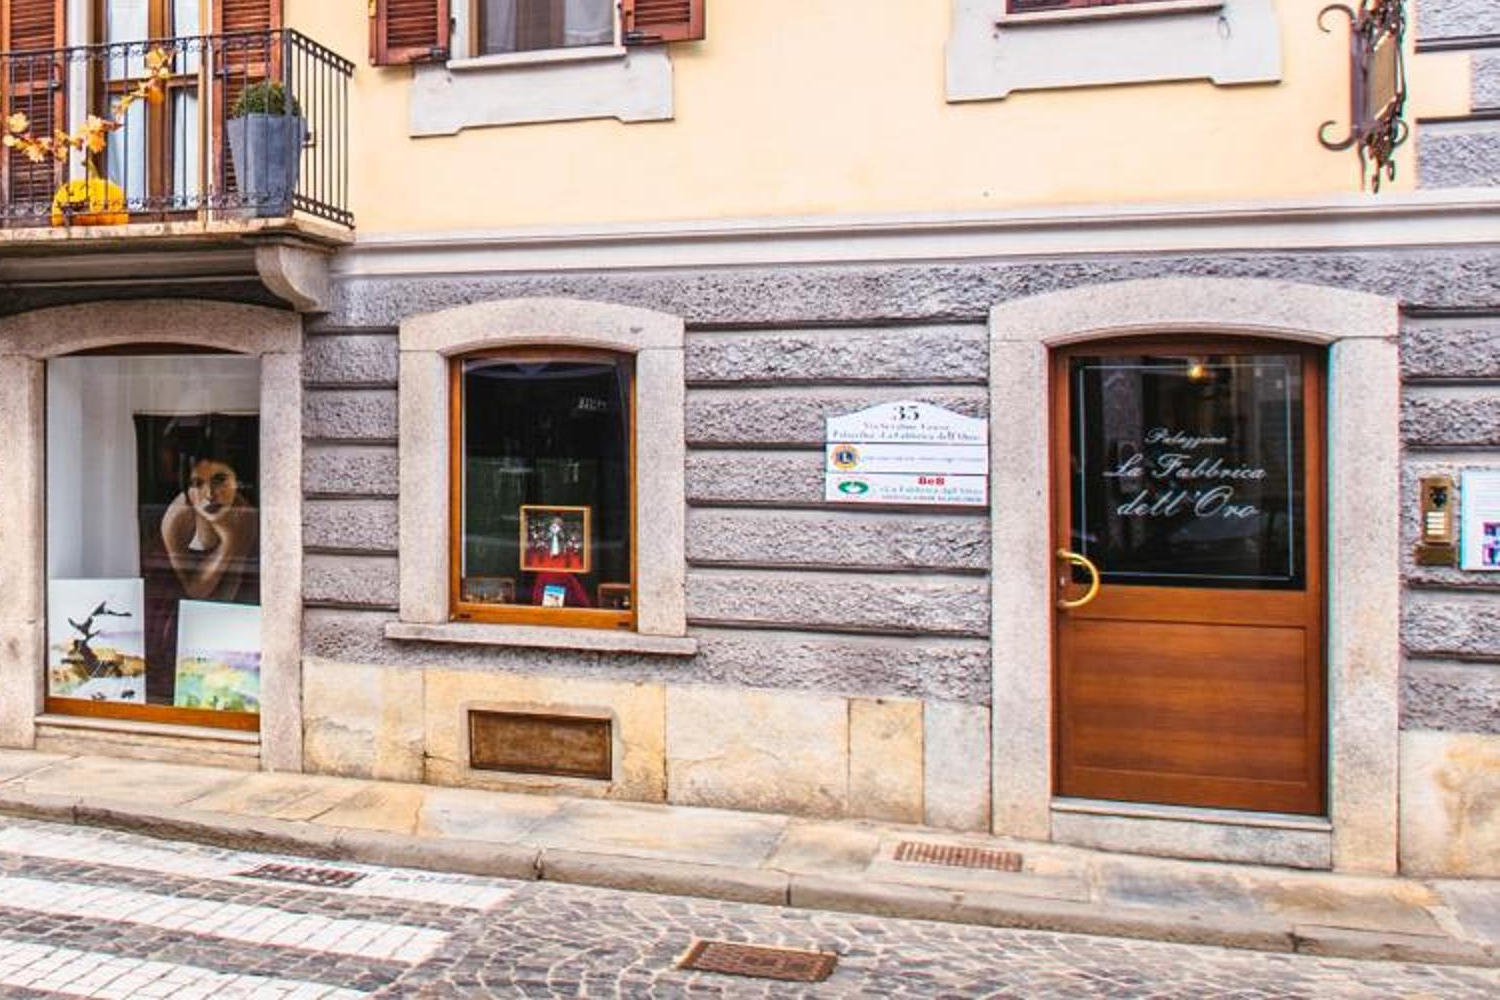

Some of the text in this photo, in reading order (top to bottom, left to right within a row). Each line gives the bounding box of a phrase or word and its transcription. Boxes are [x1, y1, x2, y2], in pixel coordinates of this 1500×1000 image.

[892, 404, 920, 421] 35
[1145, 427, 1229, 449] Palazzina
[1102, 453, 1267, 480] La Fabbrica
[1116, 485, 1260, 519] dell'Oro
